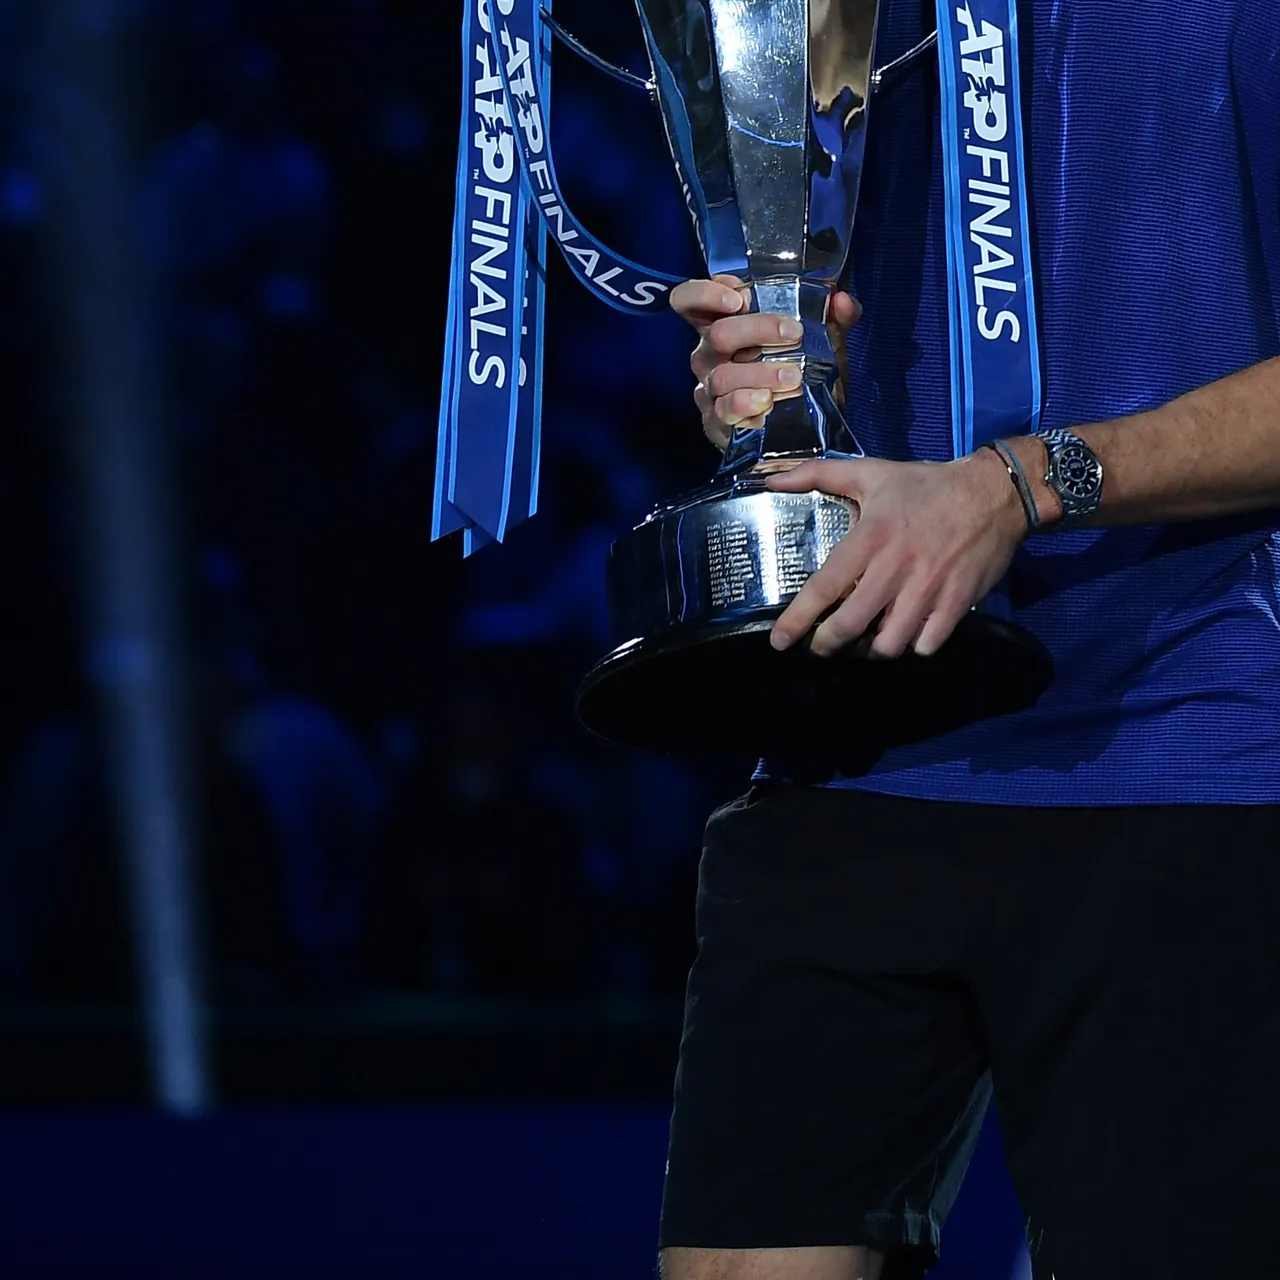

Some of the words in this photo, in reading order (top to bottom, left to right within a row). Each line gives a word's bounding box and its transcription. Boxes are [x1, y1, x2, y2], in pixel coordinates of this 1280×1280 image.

[500, 21, 544, 154] ATP
[529, 159, 669, 306] FINALS
[956, 0, 1008, 142] ATP
[468, 185, 513, 389] FINALS
[966, 144, 1021, 343] FINALS
